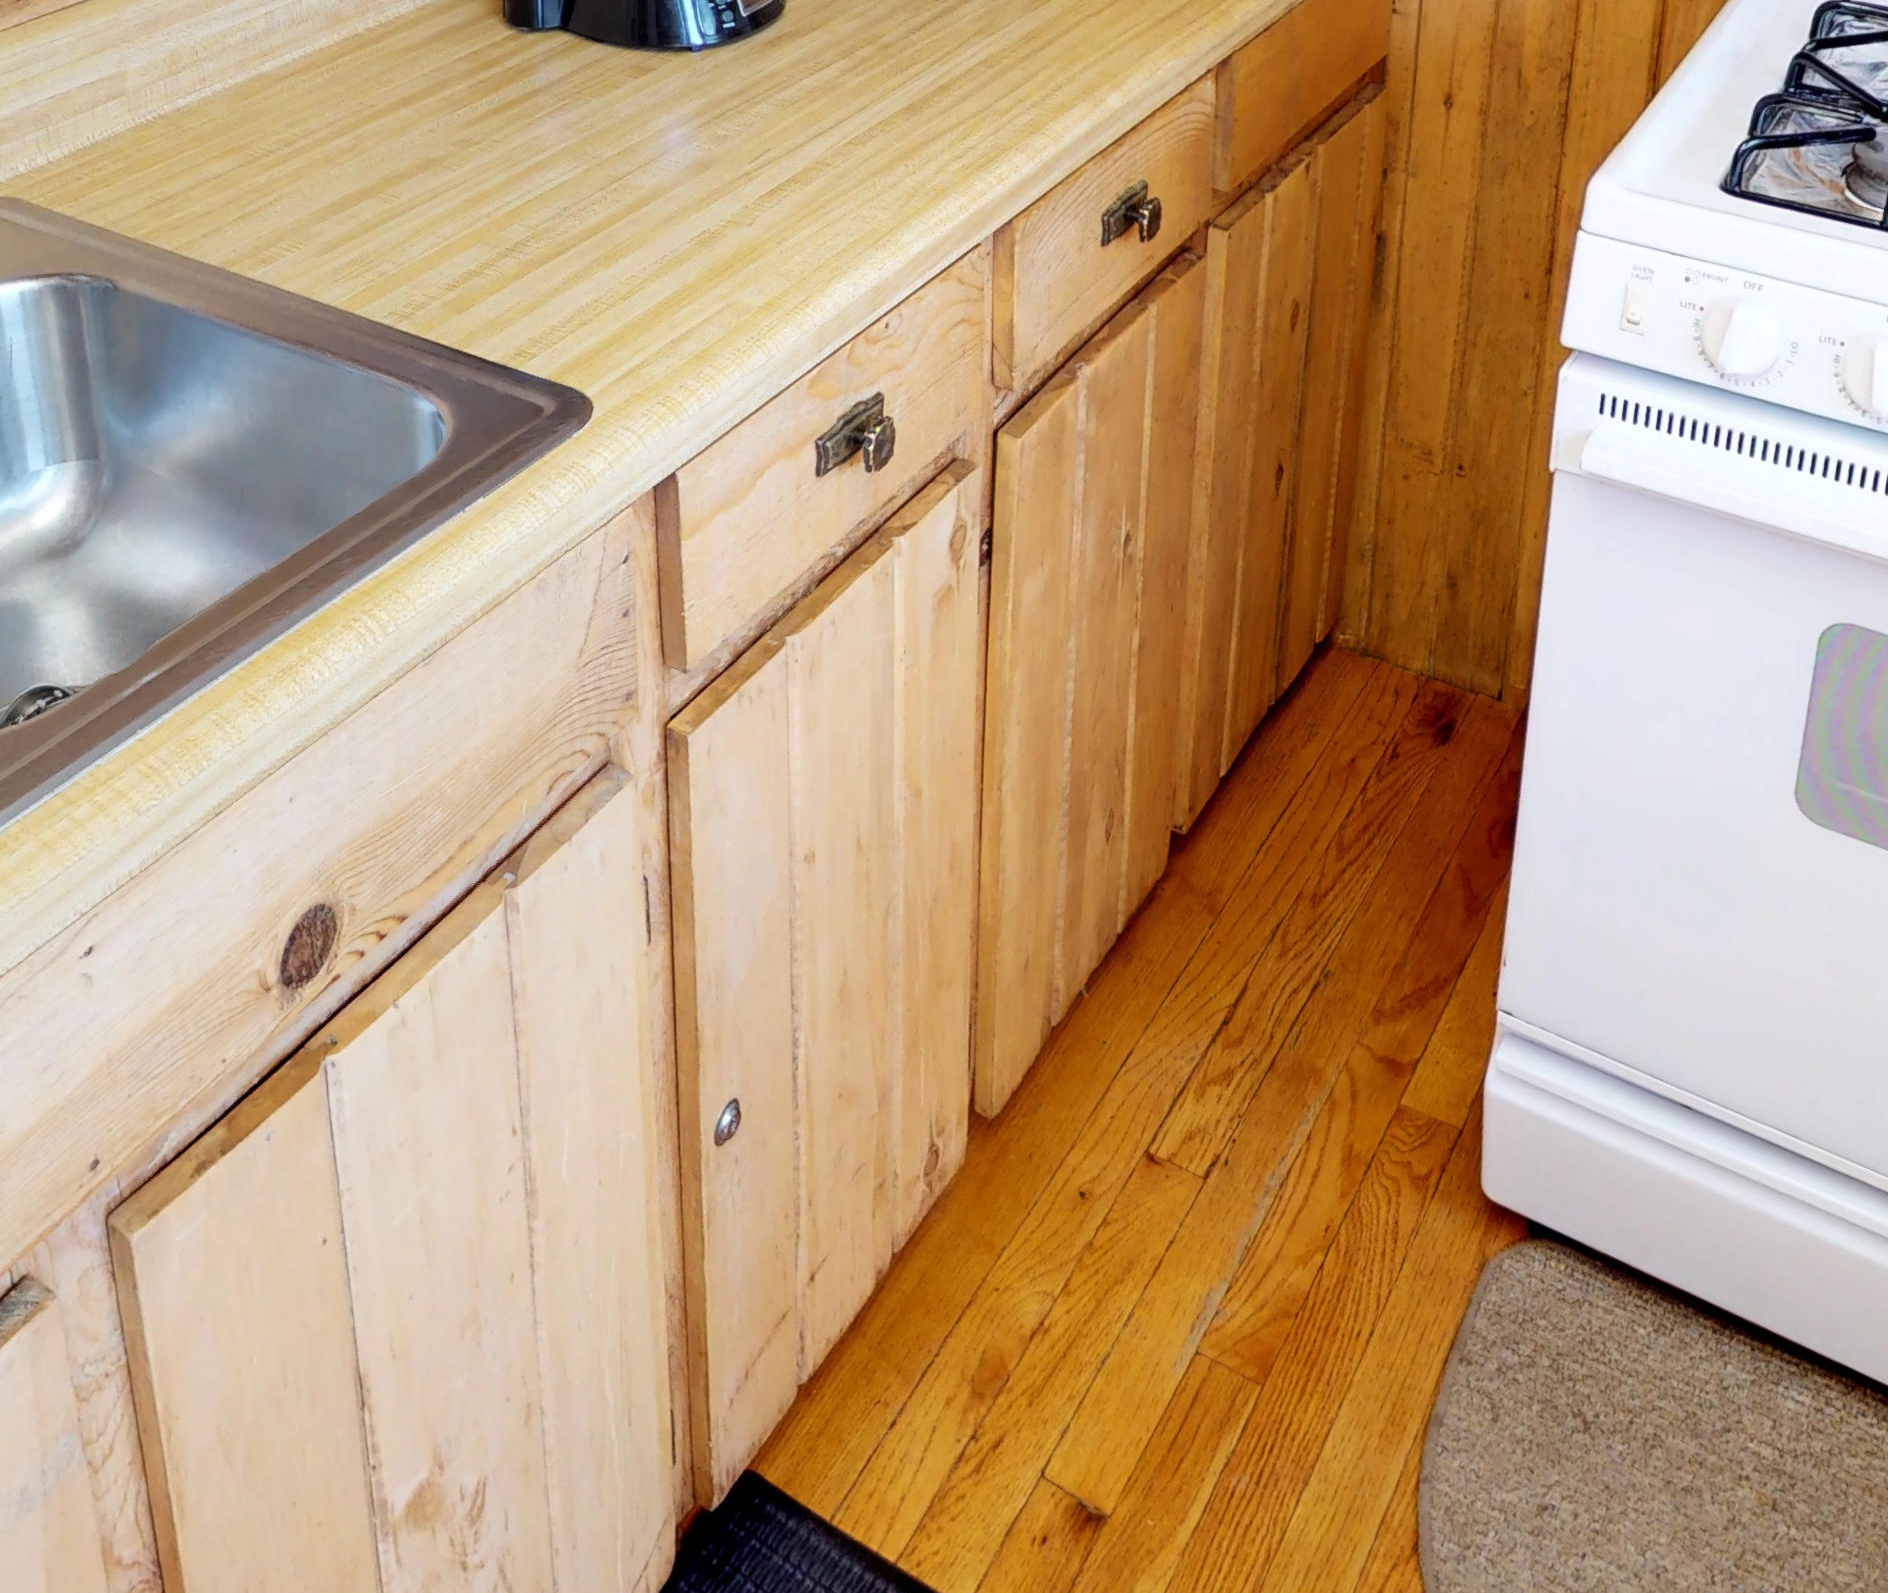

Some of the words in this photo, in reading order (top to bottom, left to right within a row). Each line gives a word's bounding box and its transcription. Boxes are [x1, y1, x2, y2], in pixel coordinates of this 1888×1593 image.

[1743, 280, 1765, 293] OFF
[1679, 300, 1697, 311] LITE
[1818, 335, 1838, 346] LITE
